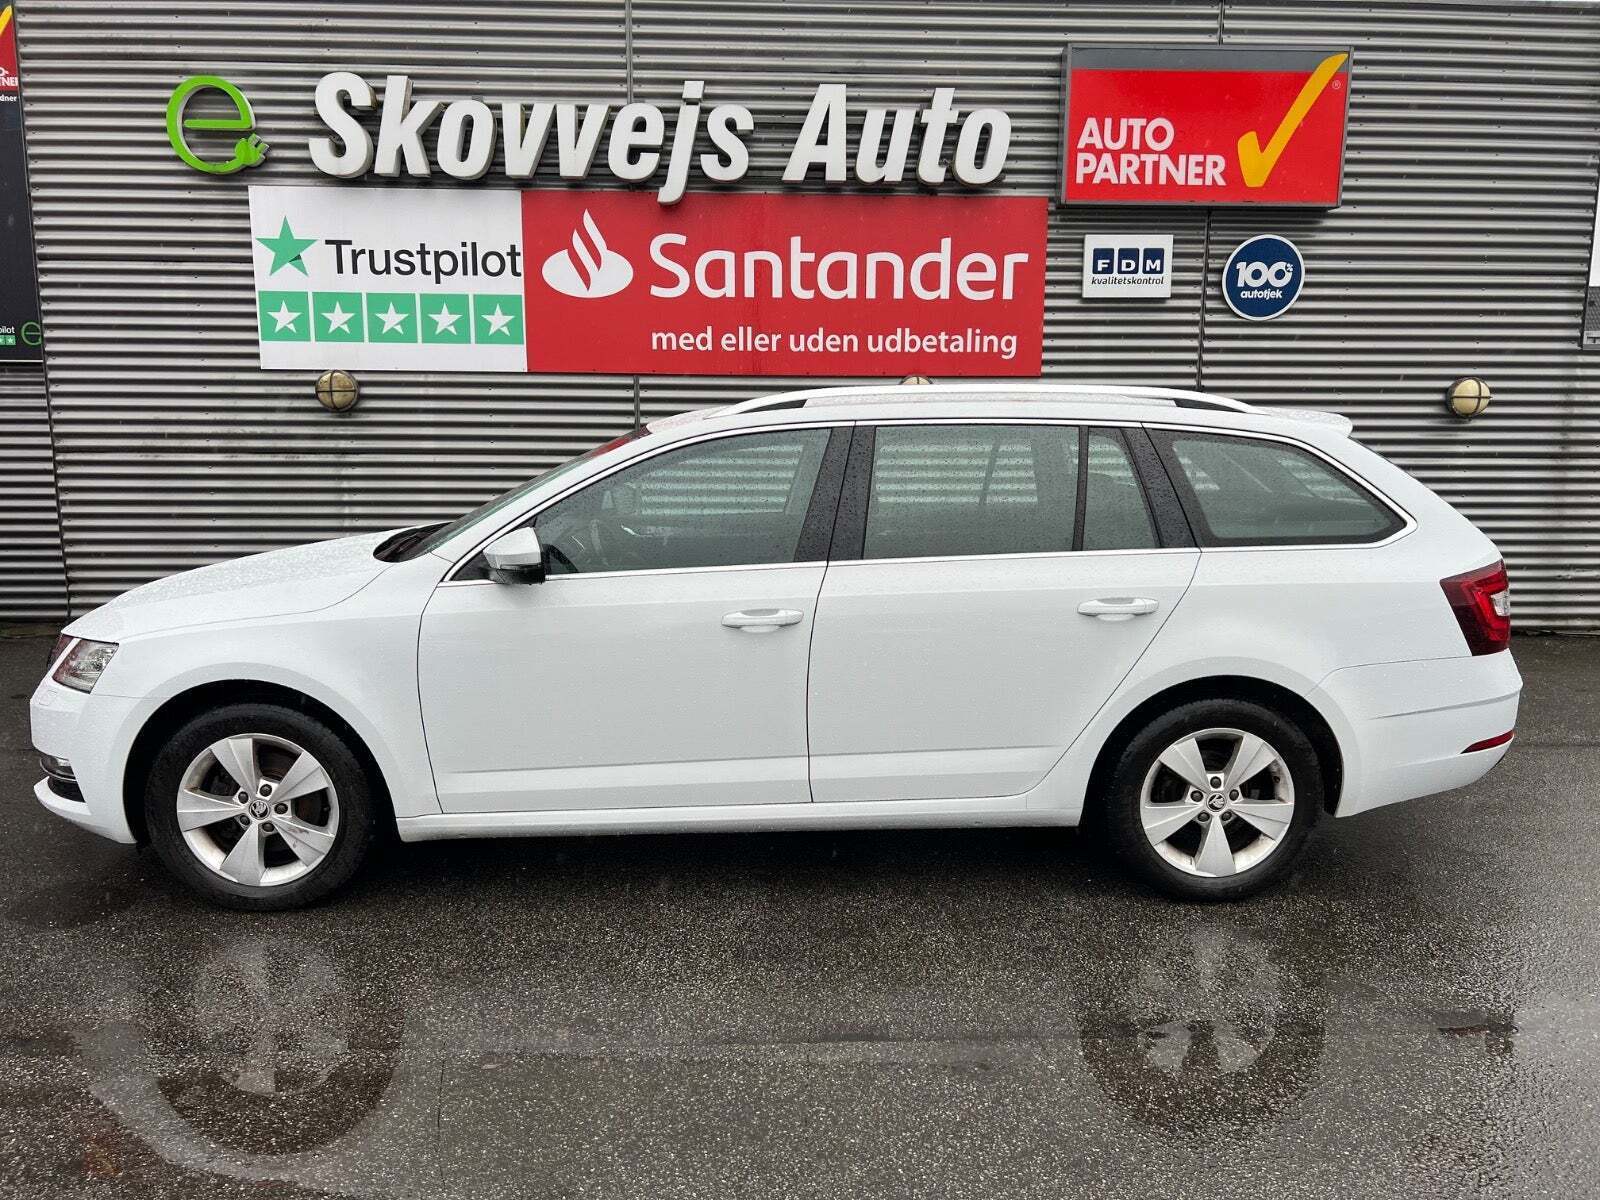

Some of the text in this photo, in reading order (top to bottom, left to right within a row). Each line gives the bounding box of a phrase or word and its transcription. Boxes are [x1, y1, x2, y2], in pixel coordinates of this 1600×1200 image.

[308, 71, 755, 206] Skovvejs
[781, 83, 1012, 186] Auto
[1076, 117, 1175, 151] AUTO
[1075, 152, 1227, 186] PARTNER
[325, 239, 522, 284] Trustpilot
[649, 233, 1030, 301] Santander
[1091, 276, 1164, 286] kvalitetskontrol
[651, 326, 1018, 360] med eller uden udbetaling
